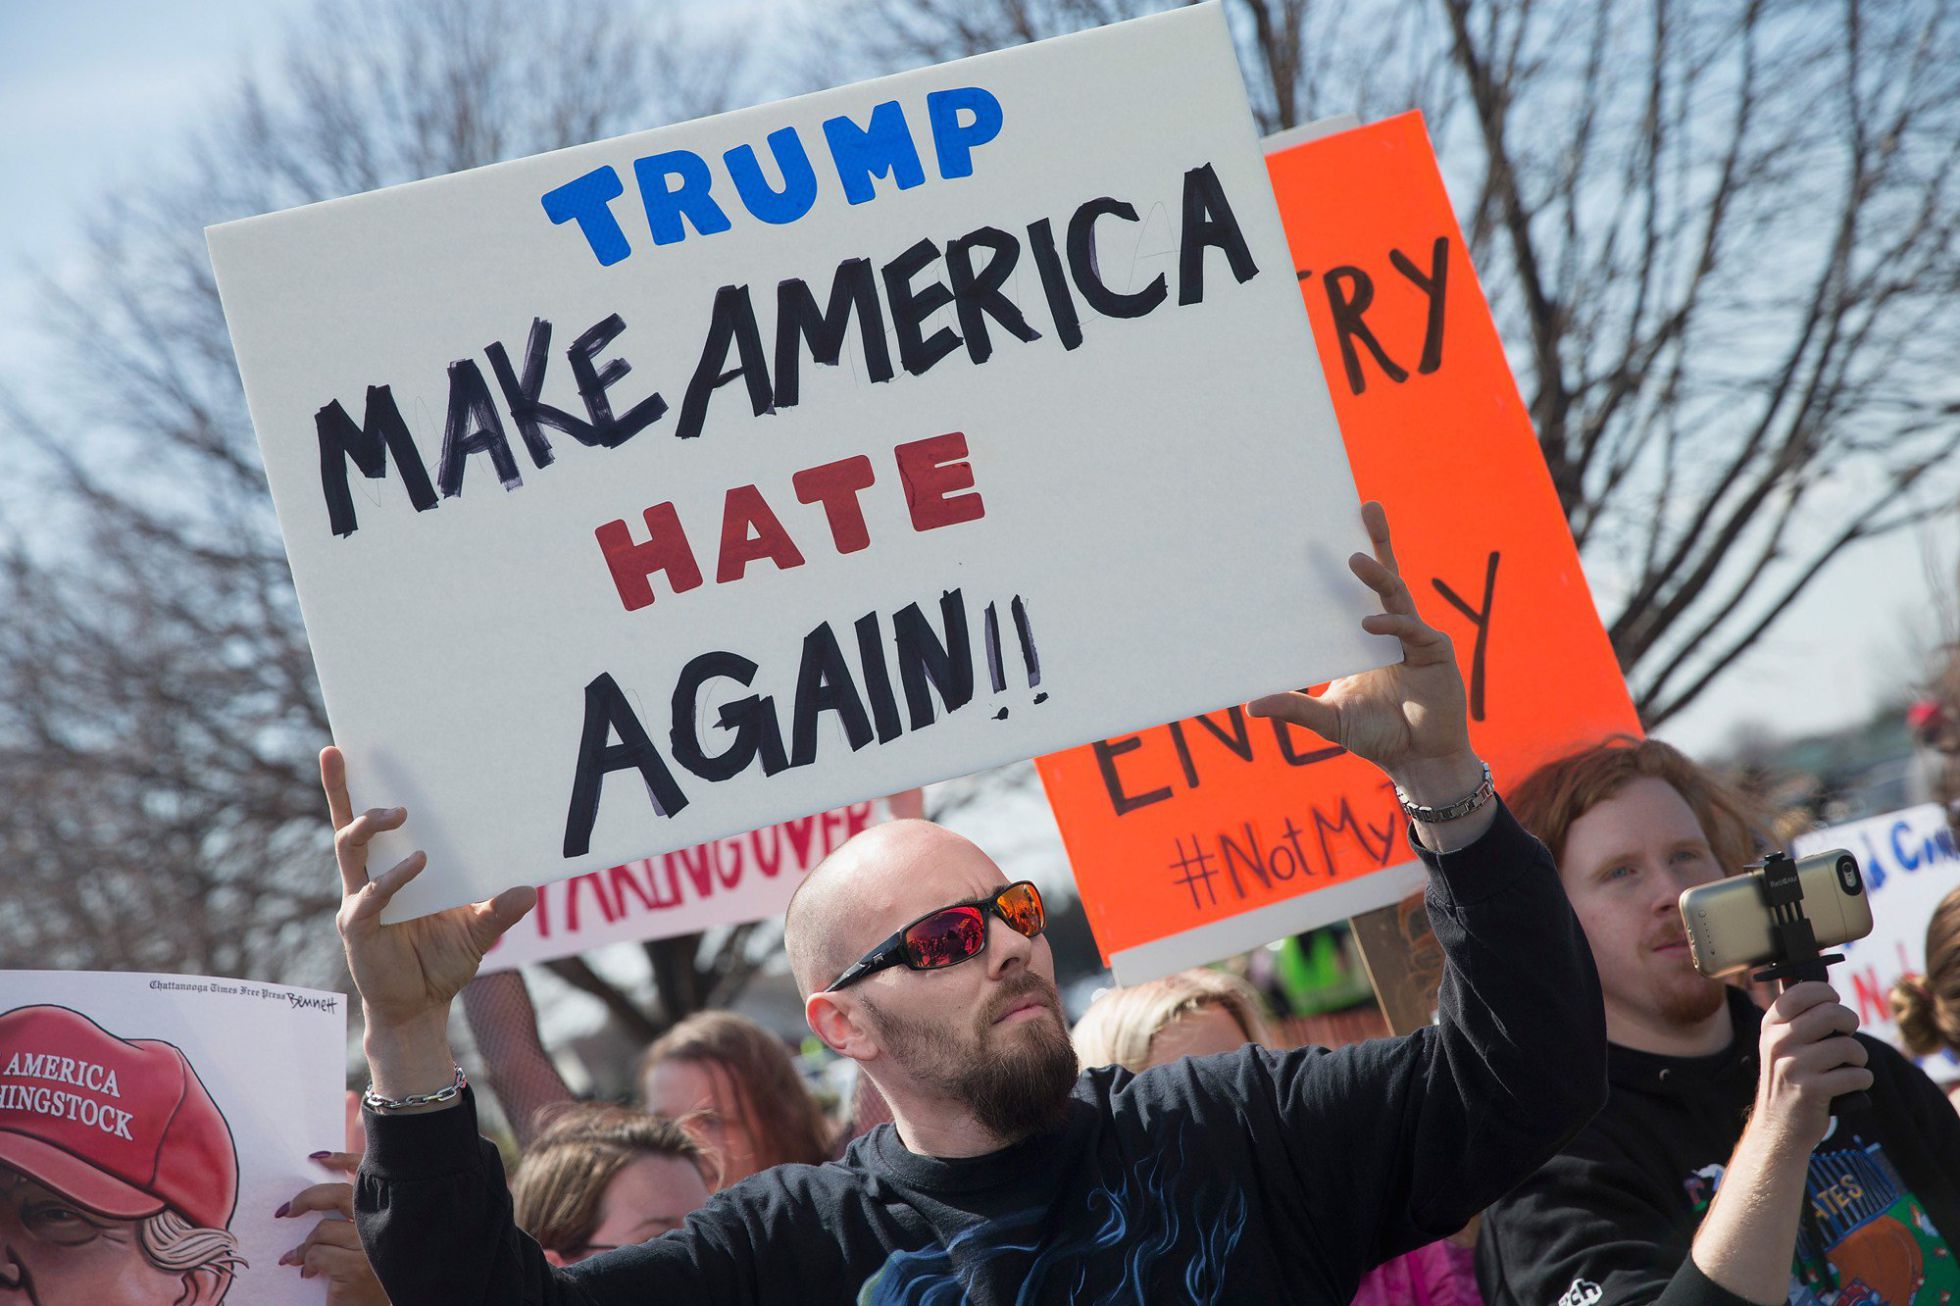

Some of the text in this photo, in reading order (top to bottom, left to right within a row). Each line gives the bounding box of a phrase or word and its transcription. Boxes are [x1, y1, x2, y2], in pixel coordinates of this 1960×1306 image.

[541, 87, 1003, 267] TRUMP
[315, 162, 1259, 539] MAKE AMERICA
[1297, 236, 1449, 396] RY
[597, 433, 984, 610] HATE
[563, 588, 1049, 858] AGAIN!!
[1169, 780, 1408, 910] #NotMy
[150, 980, 286, 1001] Chattanooga Times Free Press
[3, 1052, 120, 1098] AMERICA
